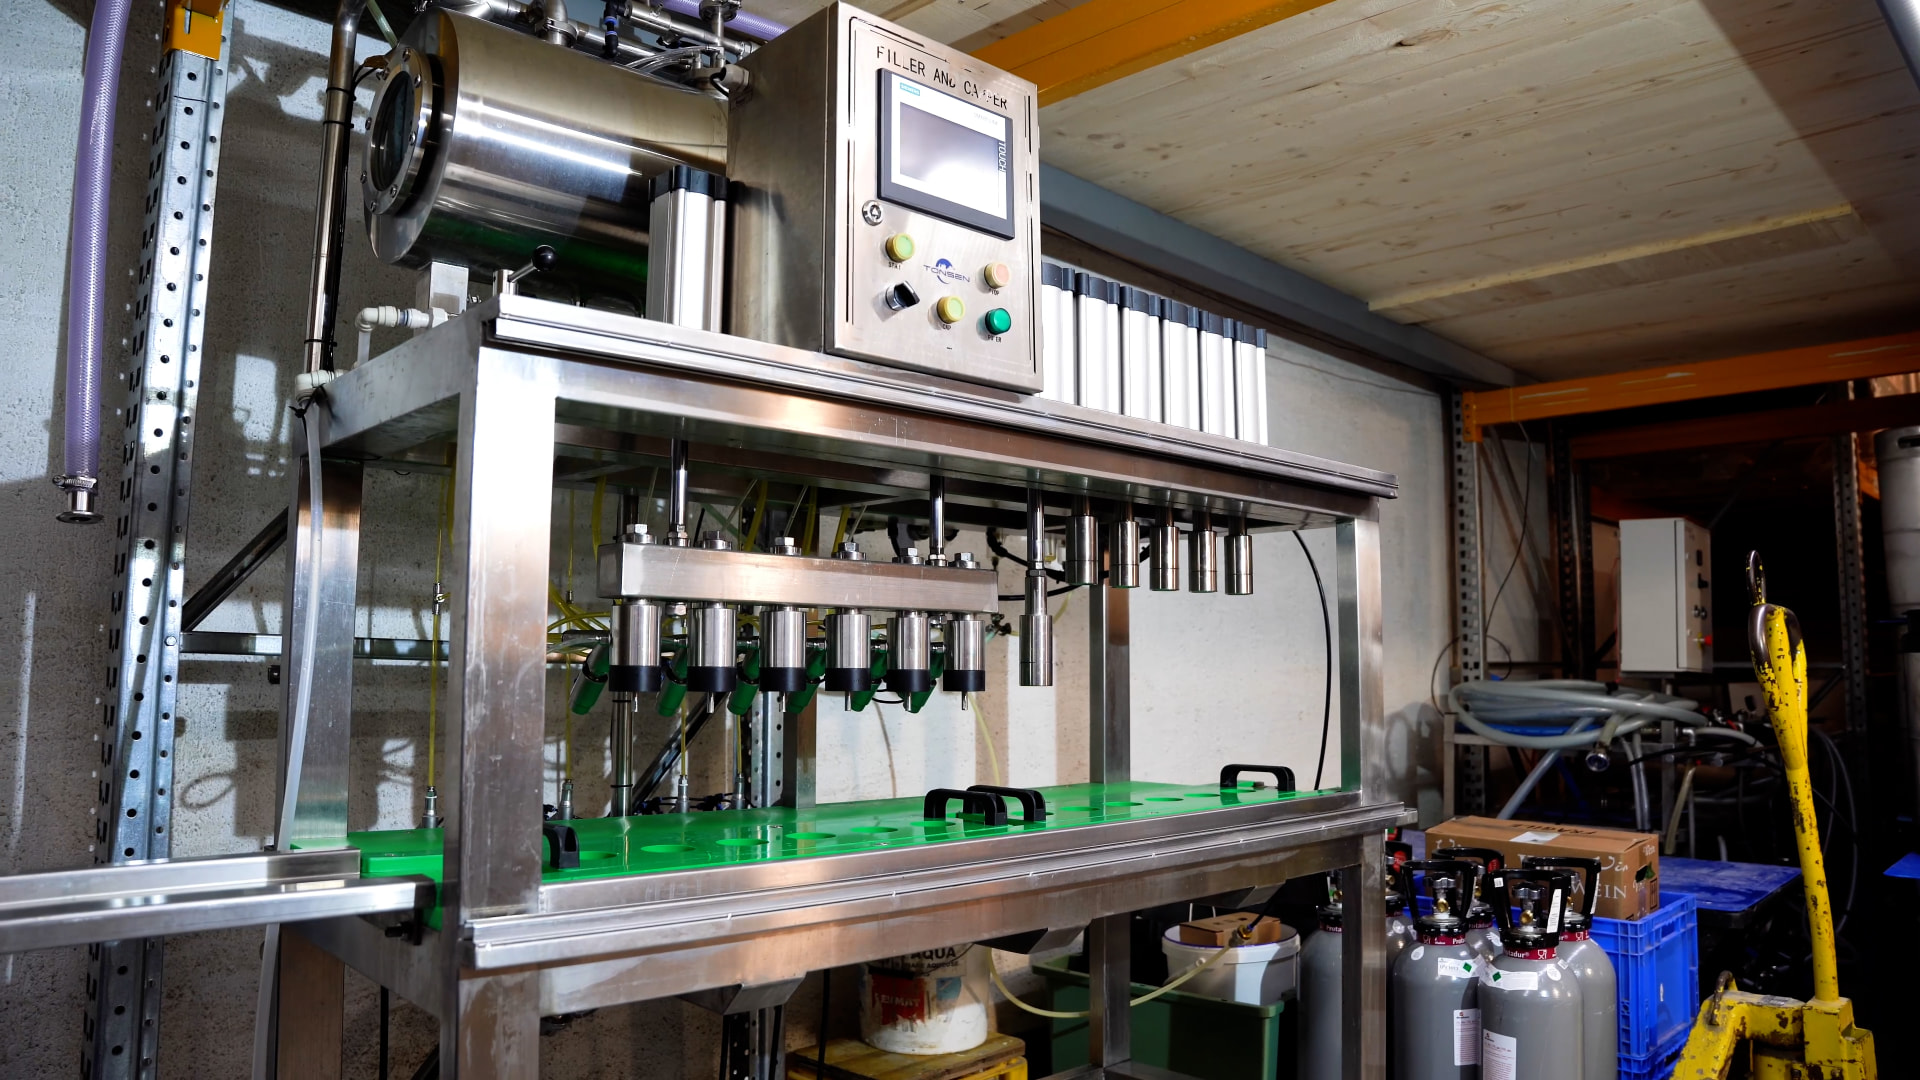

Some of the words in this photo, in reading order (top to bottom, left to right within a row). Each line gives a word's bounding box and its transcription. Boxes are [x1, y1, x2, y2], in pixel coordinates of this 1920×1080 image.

[876, 45, 926, 78] FILLER
[933, 67, 957, 89] AND
[963, 79, 1008, 111] CAER
[998, 142, 1007, 172] TOUCH
[923, 264, 971, 283] TONSEN
[987, 334, 1002, 343] POER
[910, 946, 957, 960] AQUA
